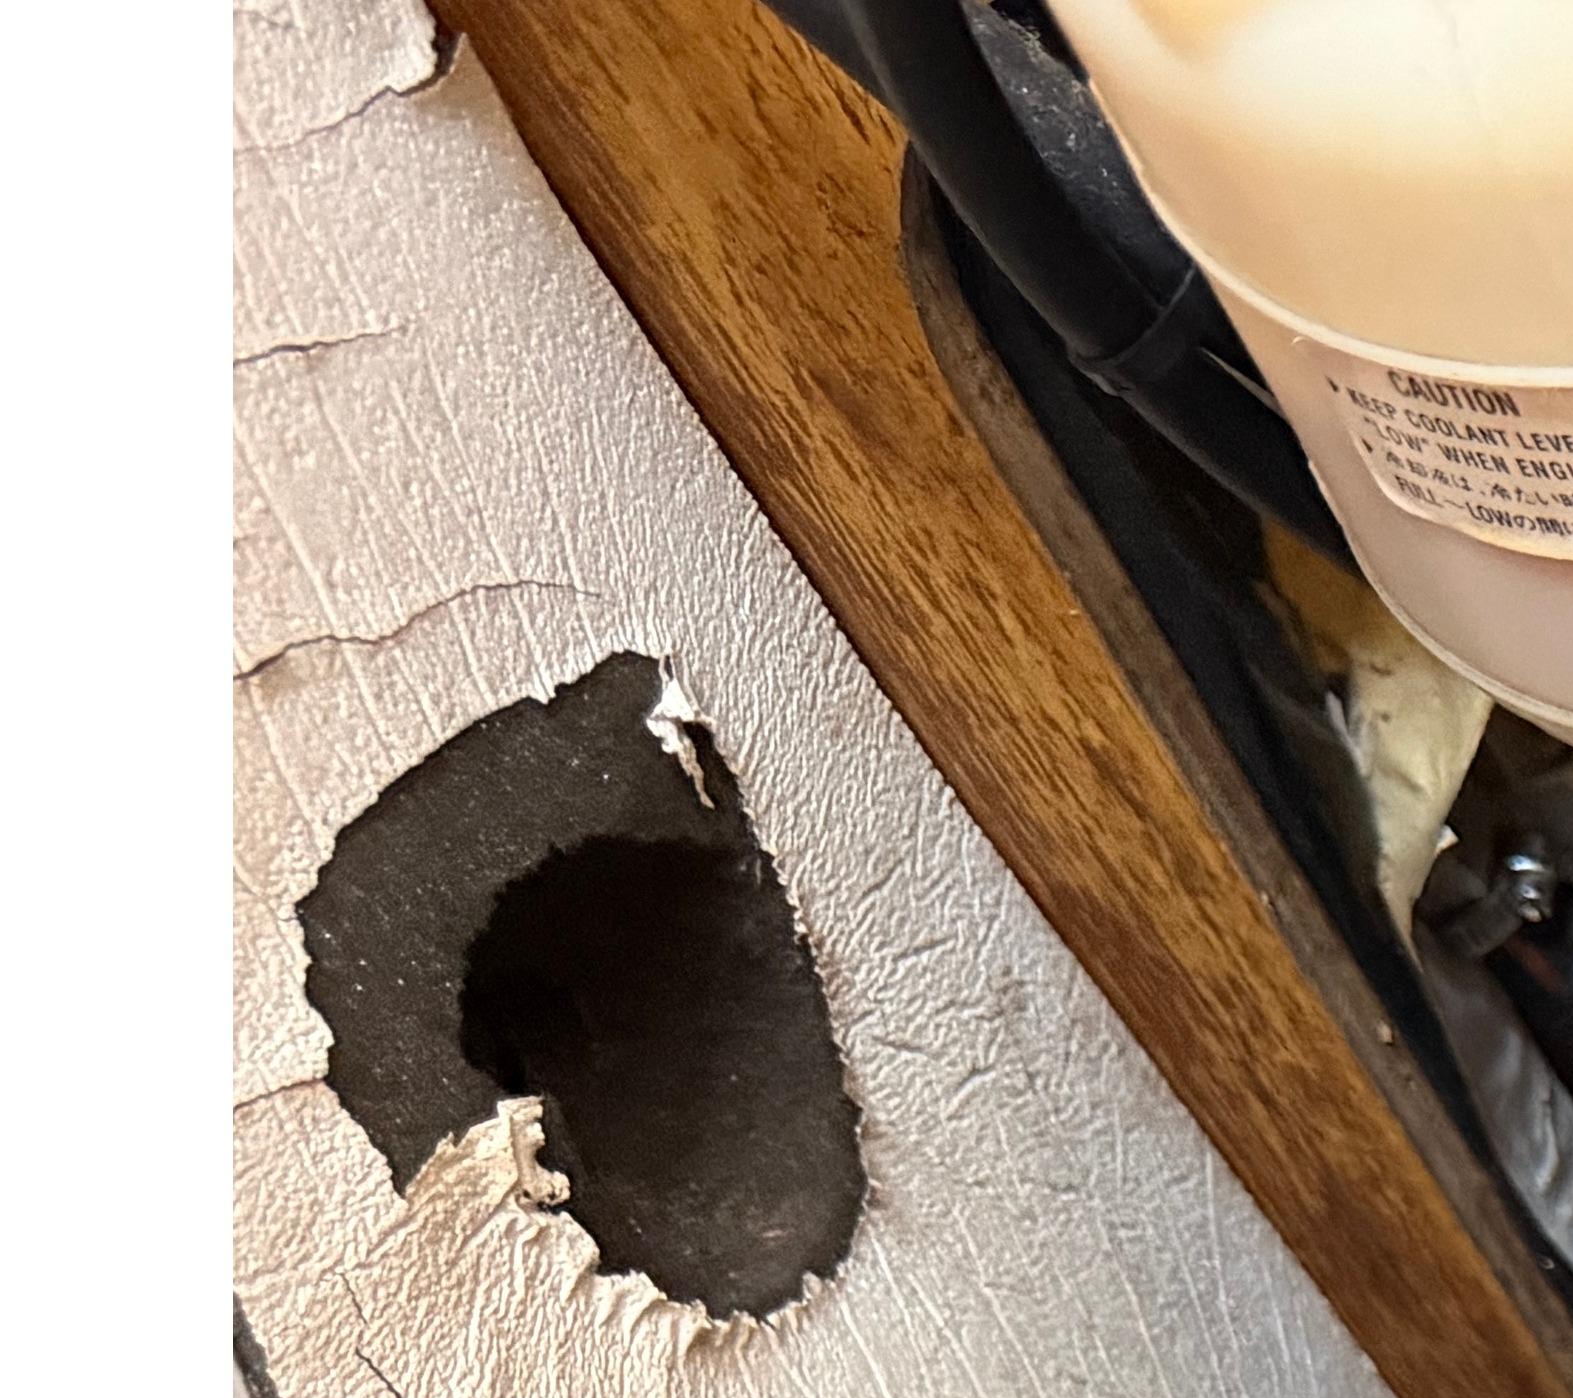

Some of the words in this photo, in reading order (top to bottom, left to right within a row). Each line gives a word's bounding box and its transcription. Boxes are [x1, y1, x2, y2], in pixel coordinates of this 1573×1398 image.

[1348, 386, 1398, 421] KEEP
[1404, 408, 1510, 448] COOLANT
[1387, 369, 1521, 418] CAUTION
[1363, 416, 1431, 451] "LOW"
[1437, 442, 1511, 476] WHEN
